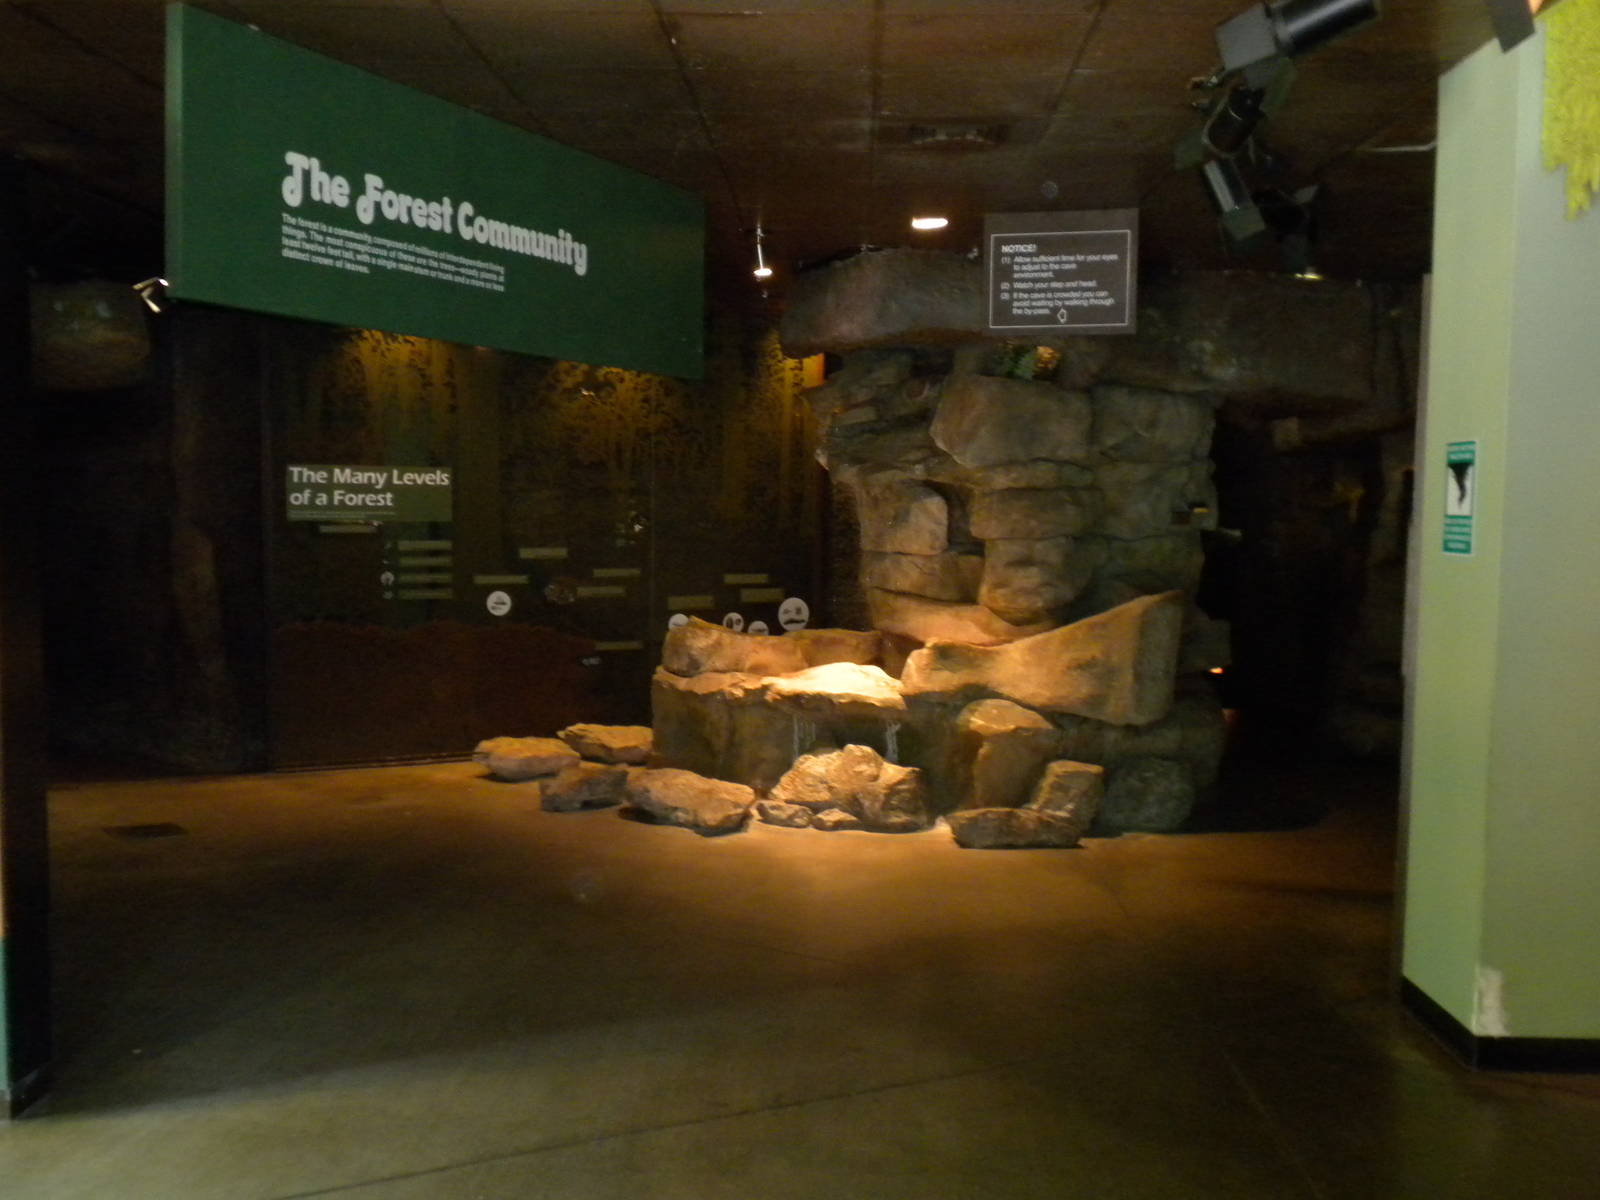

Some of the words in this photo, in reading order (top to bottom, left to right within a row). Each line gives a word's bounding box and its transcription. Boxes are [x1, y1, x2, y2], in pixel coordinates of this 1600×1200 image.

[282, 150, 350, 207] The
[356, 173, 453, 234] Forest
[457, 201, 587, 276] Community
[1001, 244, 1037, 253] NOTICE!
[289, 466, 328, 483] The
[333, 468, 387, 489] Many
[392, 469, 450, 486] Levels
[289, 490, 312, 505] of
[315, 492, 328, 505] a
[333, 490, 393, 506] Forest
